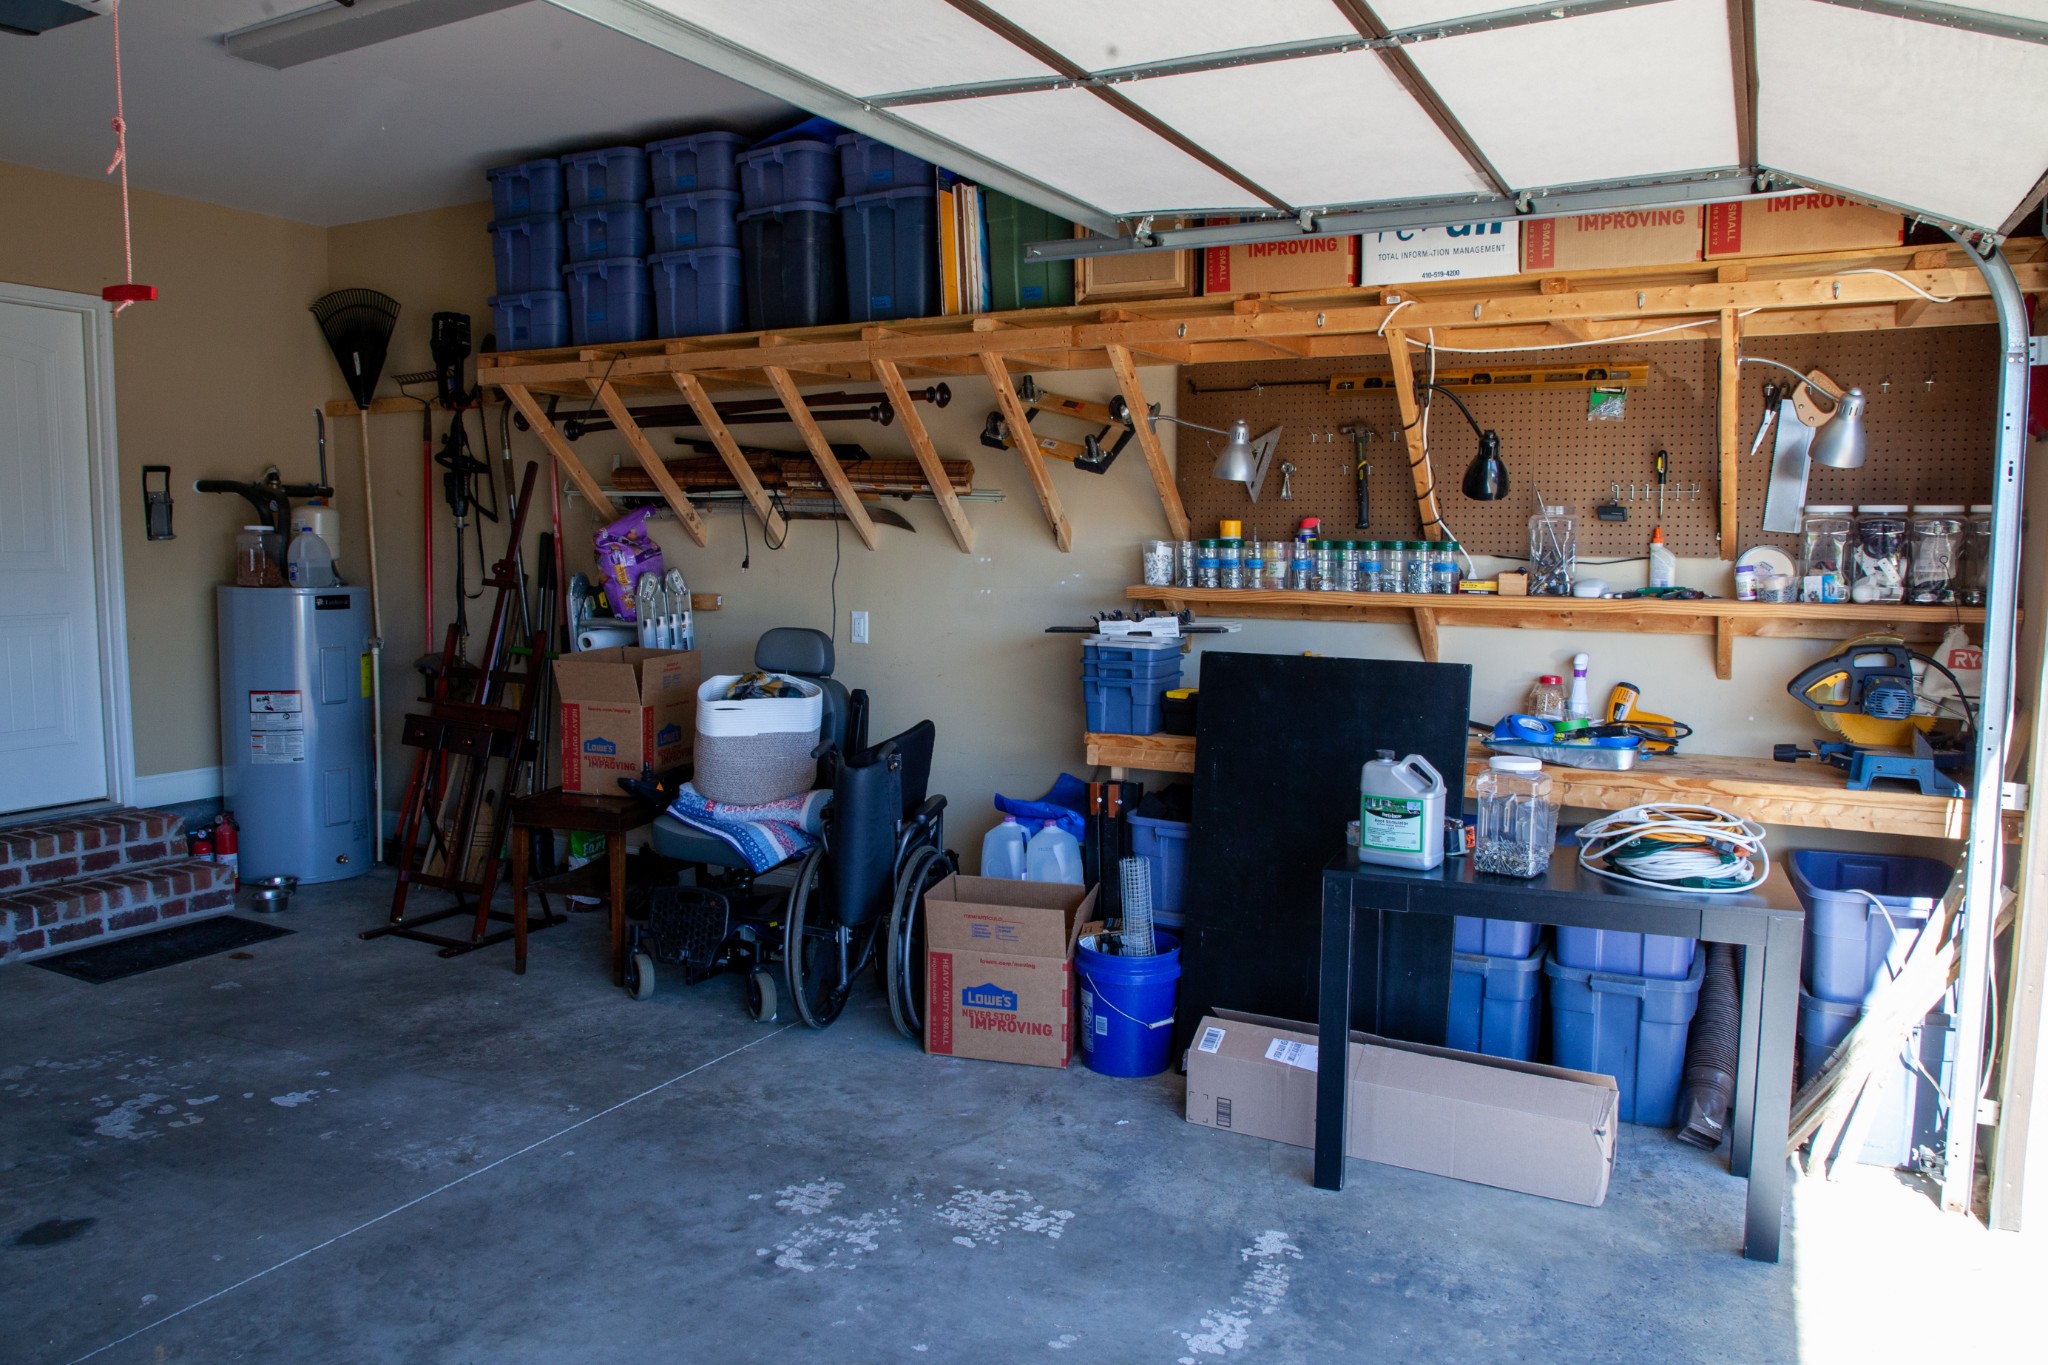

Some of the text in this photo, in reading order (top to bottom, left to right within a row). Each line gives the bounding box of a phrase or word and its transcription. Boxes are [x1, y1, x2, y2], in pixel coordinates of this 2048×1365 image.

[1767, 194, 1861, 213] IMPROV
[1577, 209, 1685, 232] IMPROVING
[1727, 203, 1737, 242] SMALL
[1248, 237, 1338, 258] IMPROVING
[1542, 223, 1551, 260] SMALL
[1378, 252, 1399, 261] TOTAL
[1453, 244, 1506, 255] MANAGEMENT
[1219, 249, 1227, 283] SMALL
[1421, 269, 1460, 279] 410-519-4200
[586, 742, 613, 753] LOWE'S
[588, 760, 636, 771] IMPROVING
[942, 958, 950, 1045] HEAVY DUTY SMALL
[967, 991, 1012, 1007] LOWE'S
[962, 1009, 1017, 1021] NEVER STOP
[969, 1016, 1053, 1037] IMPROVING
